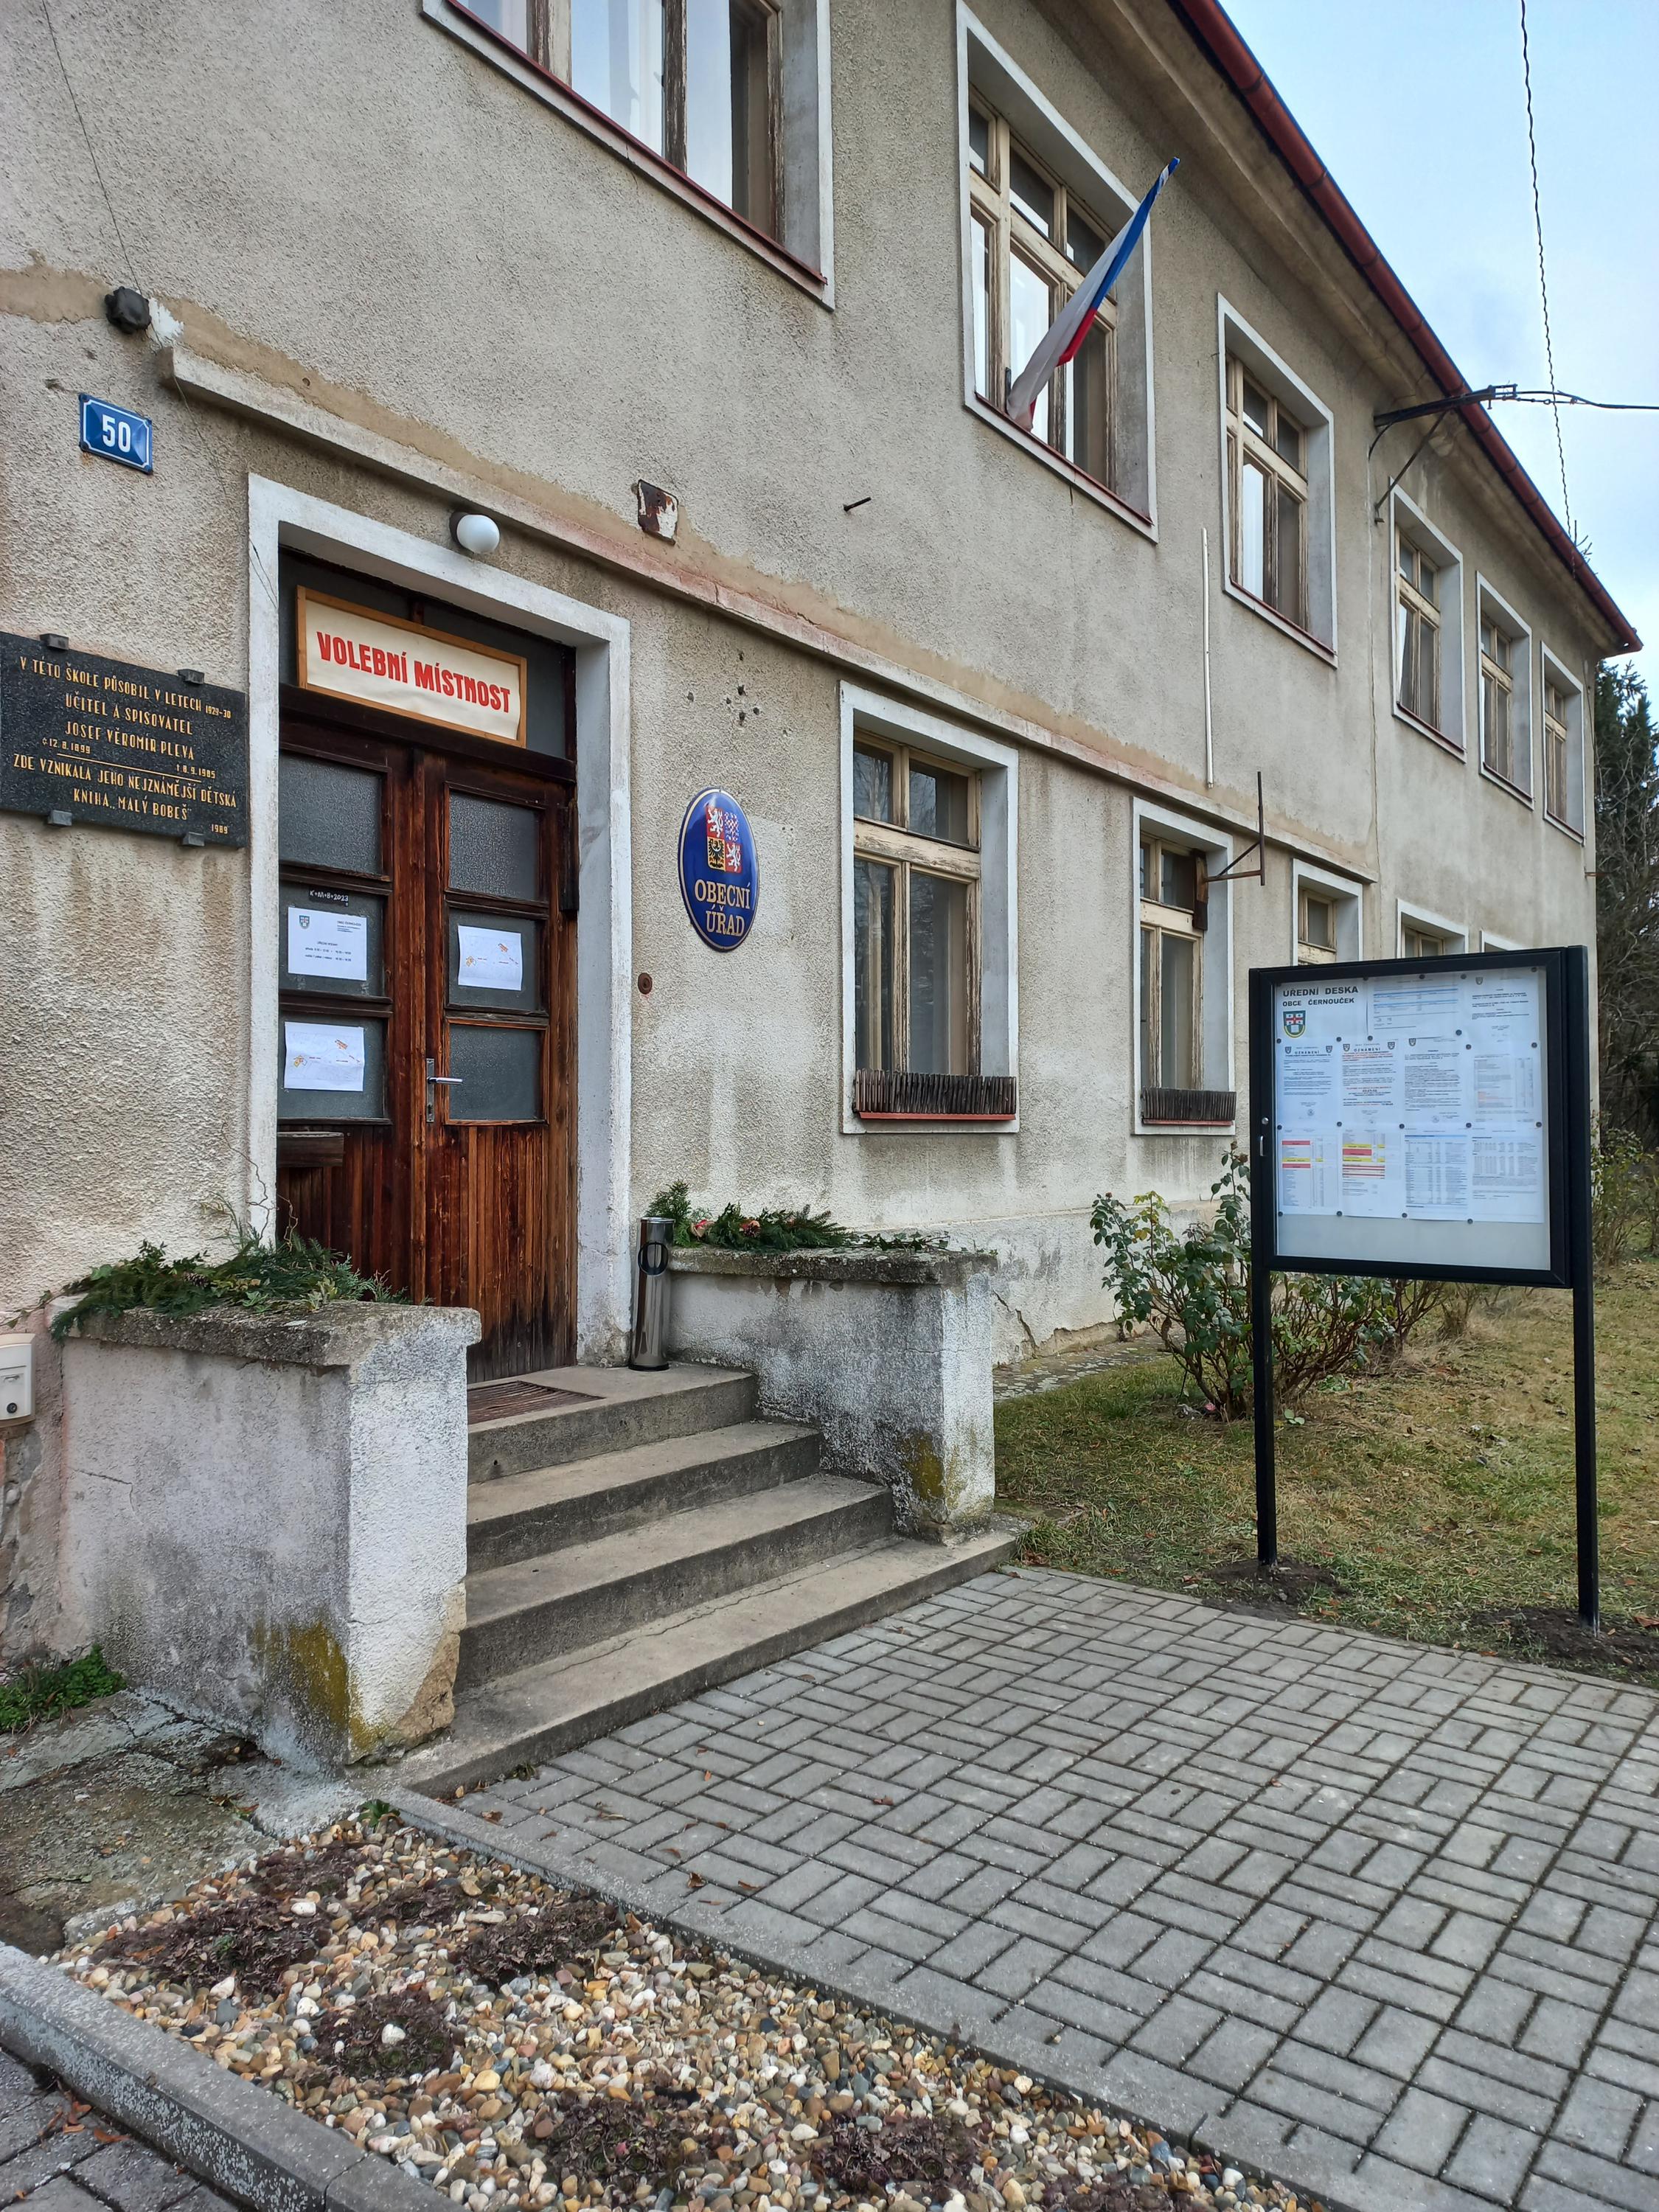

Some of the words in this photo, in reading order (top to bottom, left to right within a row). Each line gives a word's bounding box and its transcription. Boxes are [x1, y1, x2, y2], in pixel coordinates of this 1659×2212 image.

[102, 414, 131, 453] 50
[20, 656, 27, 670] V
[32, 655, 60, 678] TÉTO
[66, 661, 99, 687] ŠKOLE
[104, 675, 150, 699] PŮSOBIL
[155, 689, 161, 701] V
[165, 692, 201, 712] LETECH
[316, 632, 408, 684] VOLEBNÍ
[414, 661, 510, 713] MÍSTNOST
[65, 691, 108, 716] UČITEL
[113, 704, 120, 719] A
[125, 707, 193, 735] SPISOVATEL
[65, 721, 101, 740] JOSEF
[106, 727, 156, 752] VĚROMÍR
[161, 740, 194, 760] PLEVA
[13, 753, 35, 771] ZDE
[40, 758, 91, 781] VZNIKALA
[97, 770, 124, 787] JEHO
[128, 774, 196, 800] NEJZNÁMĚJŠÍ
[201, 786, 237, 808] DĚTSKÁ
[211, 824, 228, 835] 1989
[695, 879, 751, 909] OBECNÍ
[706, 904, 745, 937] ÚŘAD
[1283, 987, 1319, 997] ÚŘEDNÍ
[1325, 986, 1359, 995] DESKA
[1308, 998, 1355, 1006] ČERNOUČEK
